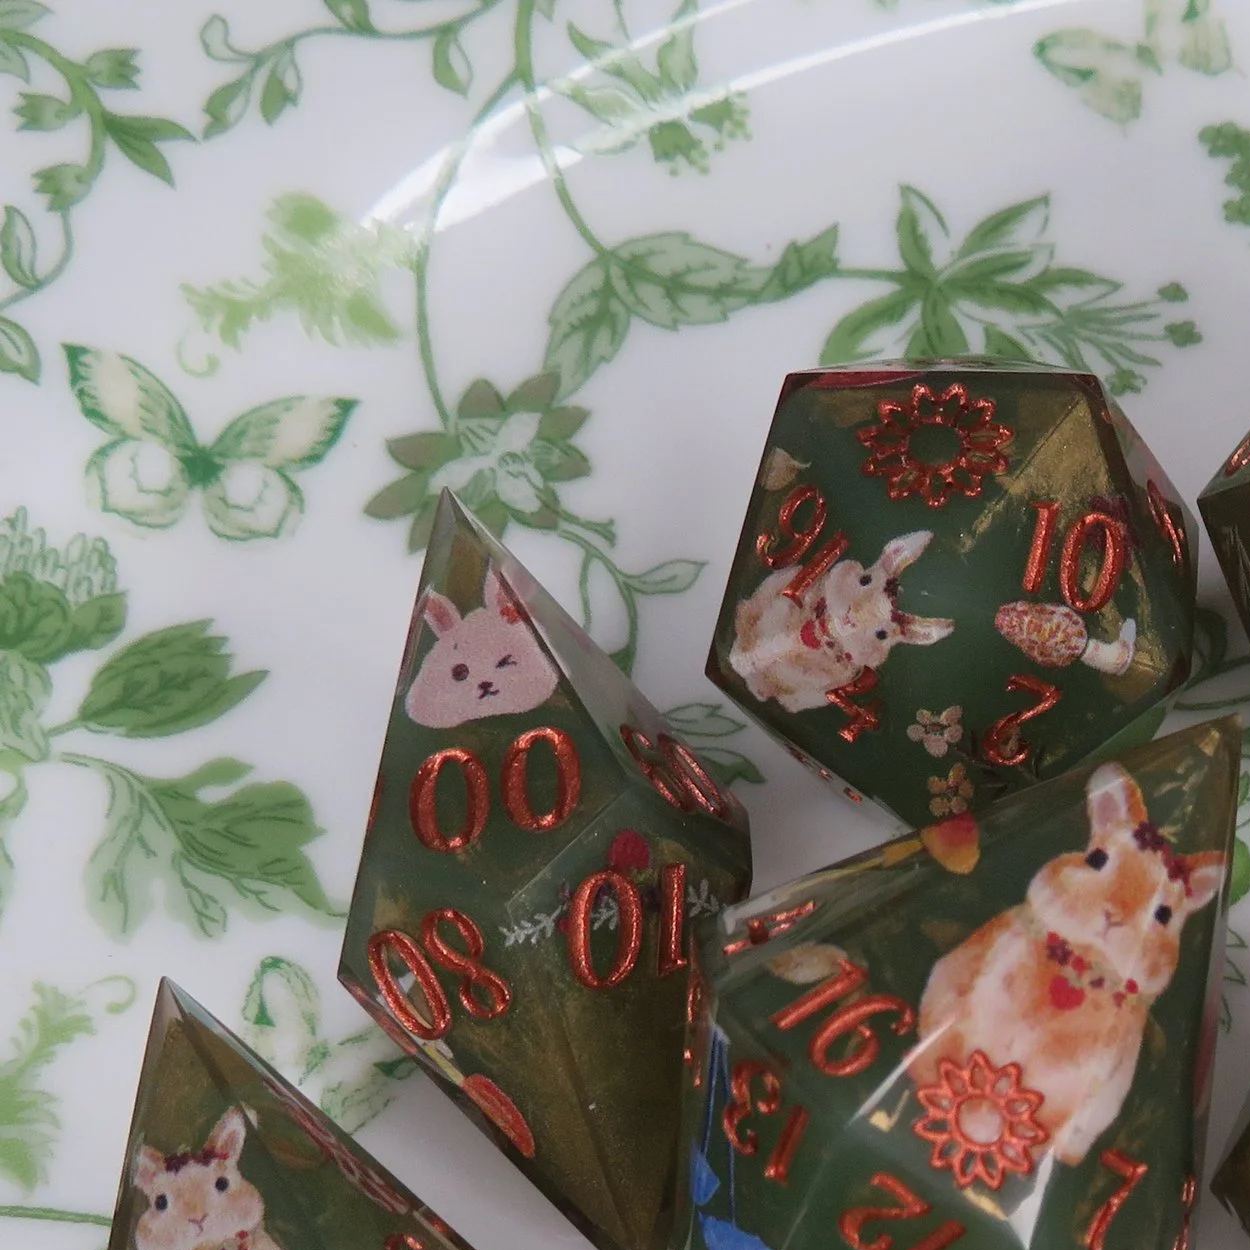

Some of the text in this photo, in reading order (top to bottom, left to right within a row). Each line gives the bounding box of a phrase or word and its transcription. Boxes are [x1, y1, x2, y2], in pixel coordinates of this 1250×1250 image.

[1032, 501, 1125, 612] 10
[983, 674, 1062, 767] 2
[408, 726, 582, 854] 00
[567, 862, 690, 990] 10
[771, 960, 917, 1077] 16
